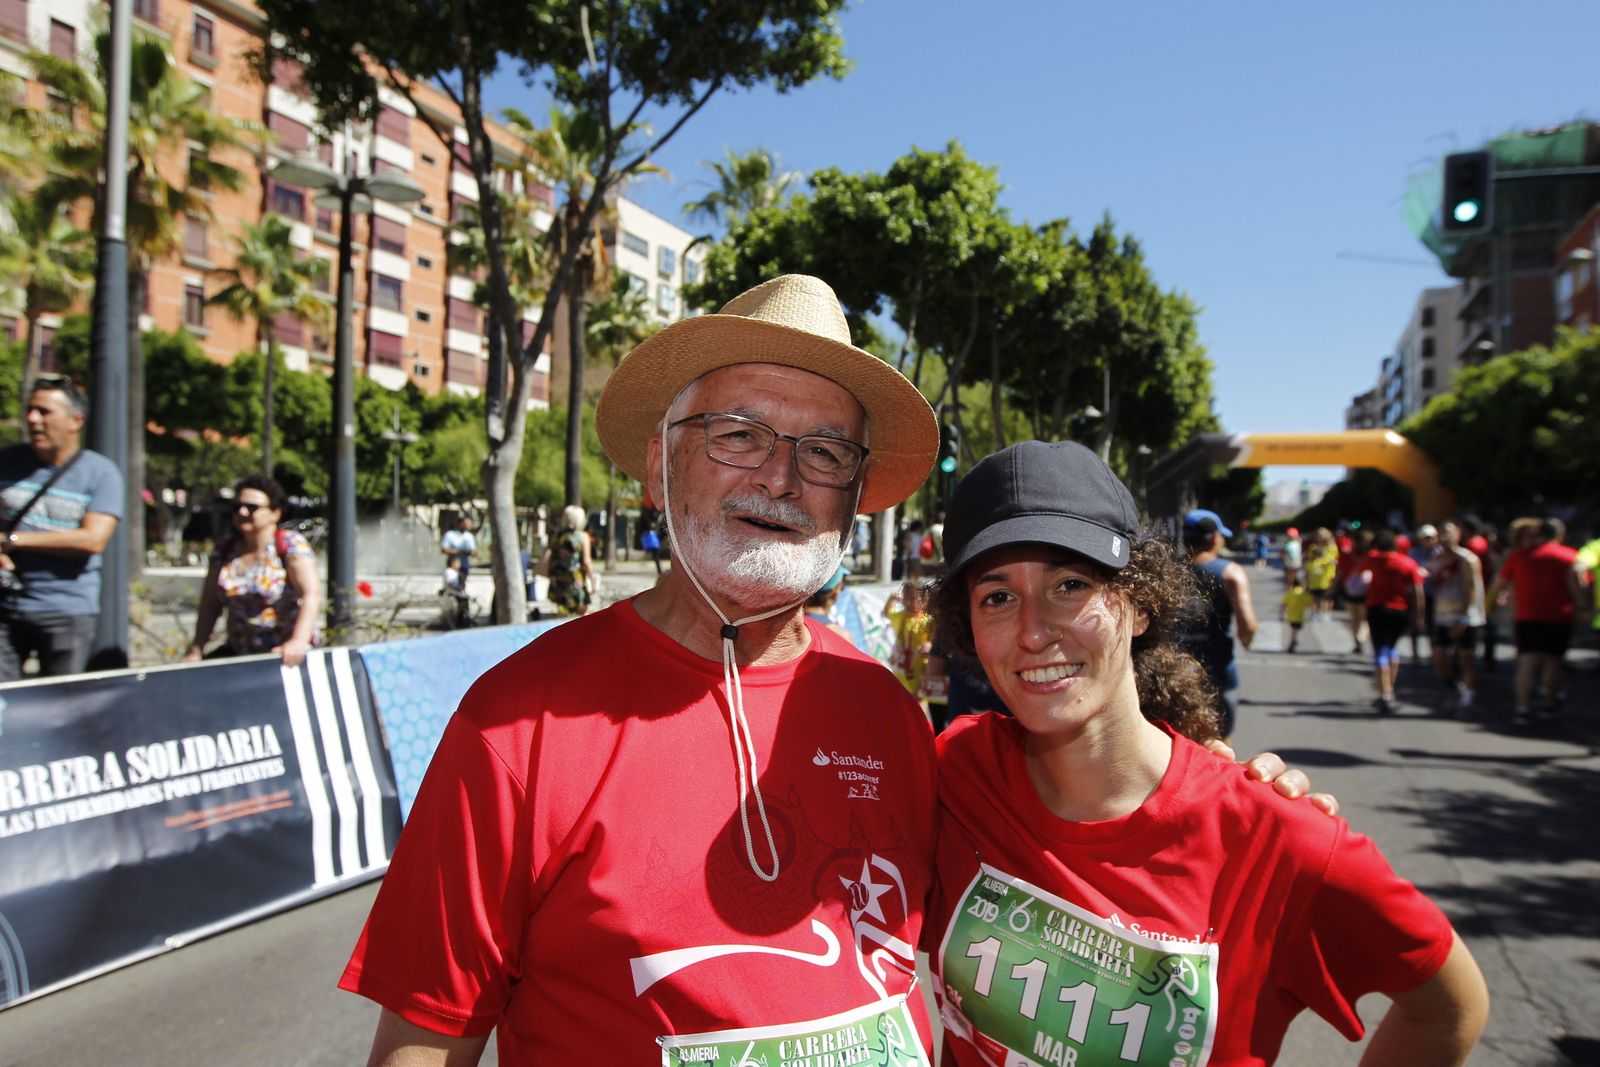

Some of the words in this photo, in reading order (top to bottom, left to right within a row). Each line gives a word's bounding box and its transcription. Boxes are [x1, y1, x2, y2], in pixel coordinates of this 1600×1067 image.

[125, 724, 283, 784] SOLIDARIA
[831, 751, 884, 770] Santander
[967, 895, 999, 923] 2019
[1040, 926, 1133, 979] SOLIDARIA
[1046, 910, 1136, 963] CARRERA
[966, 935, 1152, 1063] 1111
[779, 1023, 868, 1060] CARRERA
[1033, 1030, 1078, 1067] MAR
